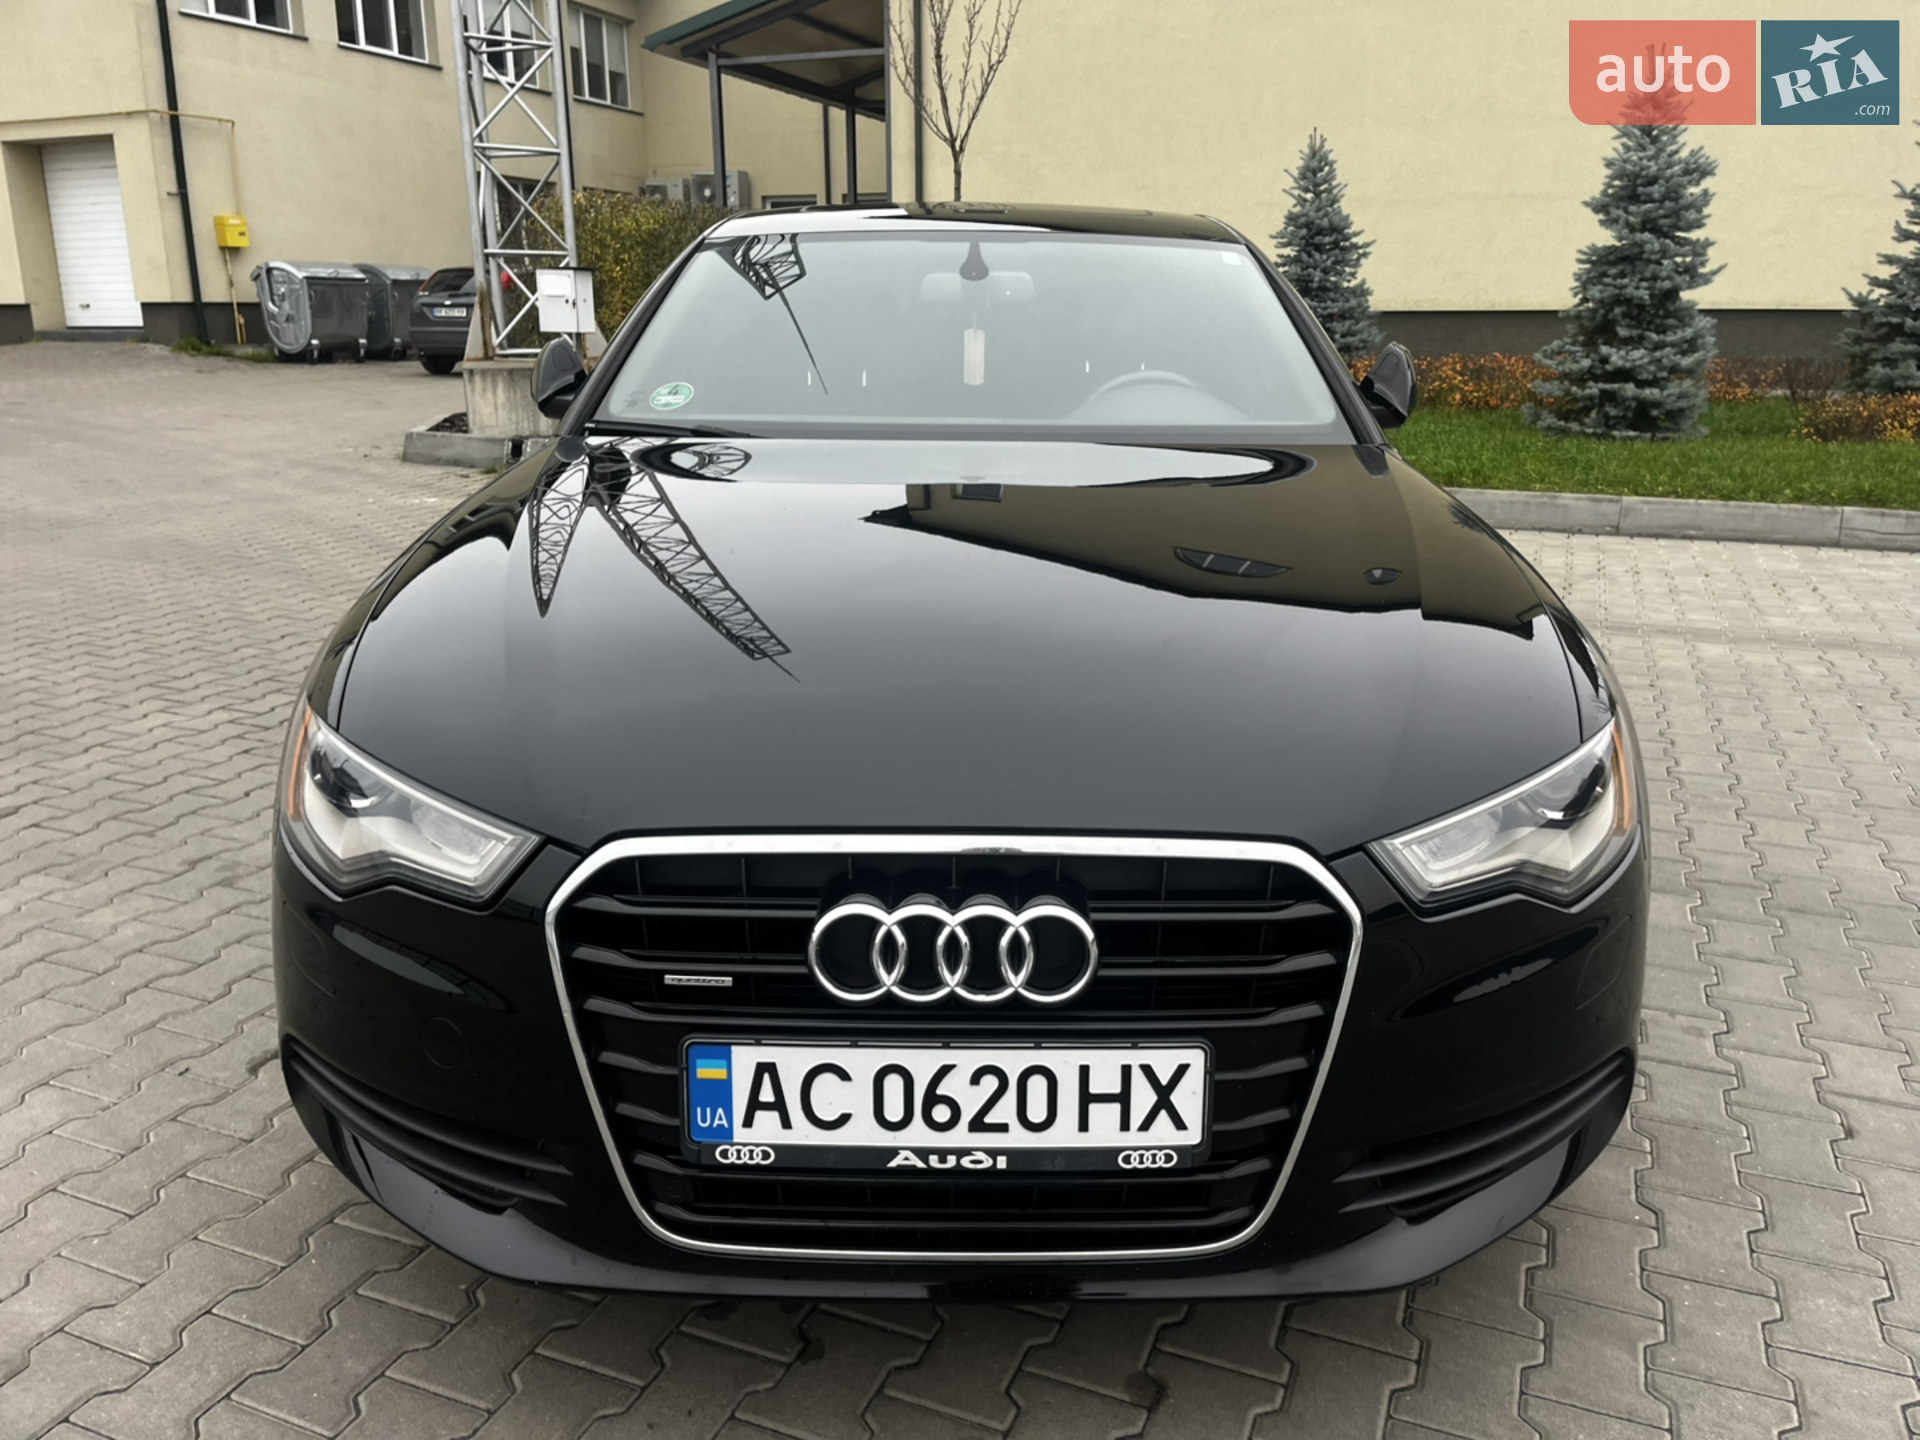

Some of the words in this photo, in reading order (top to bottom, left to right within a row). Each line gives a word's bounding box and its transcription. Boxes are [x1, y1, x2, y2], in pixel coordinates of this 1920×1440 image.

[741, 1061, 853, 1131] AC
[872, 1063, 1058, 1133] 0620
[1077, 1064, 1191, 1133] HX
[696, 1106, 729, 1128] UA
[886, 1149, 1007, 1169] Audi
